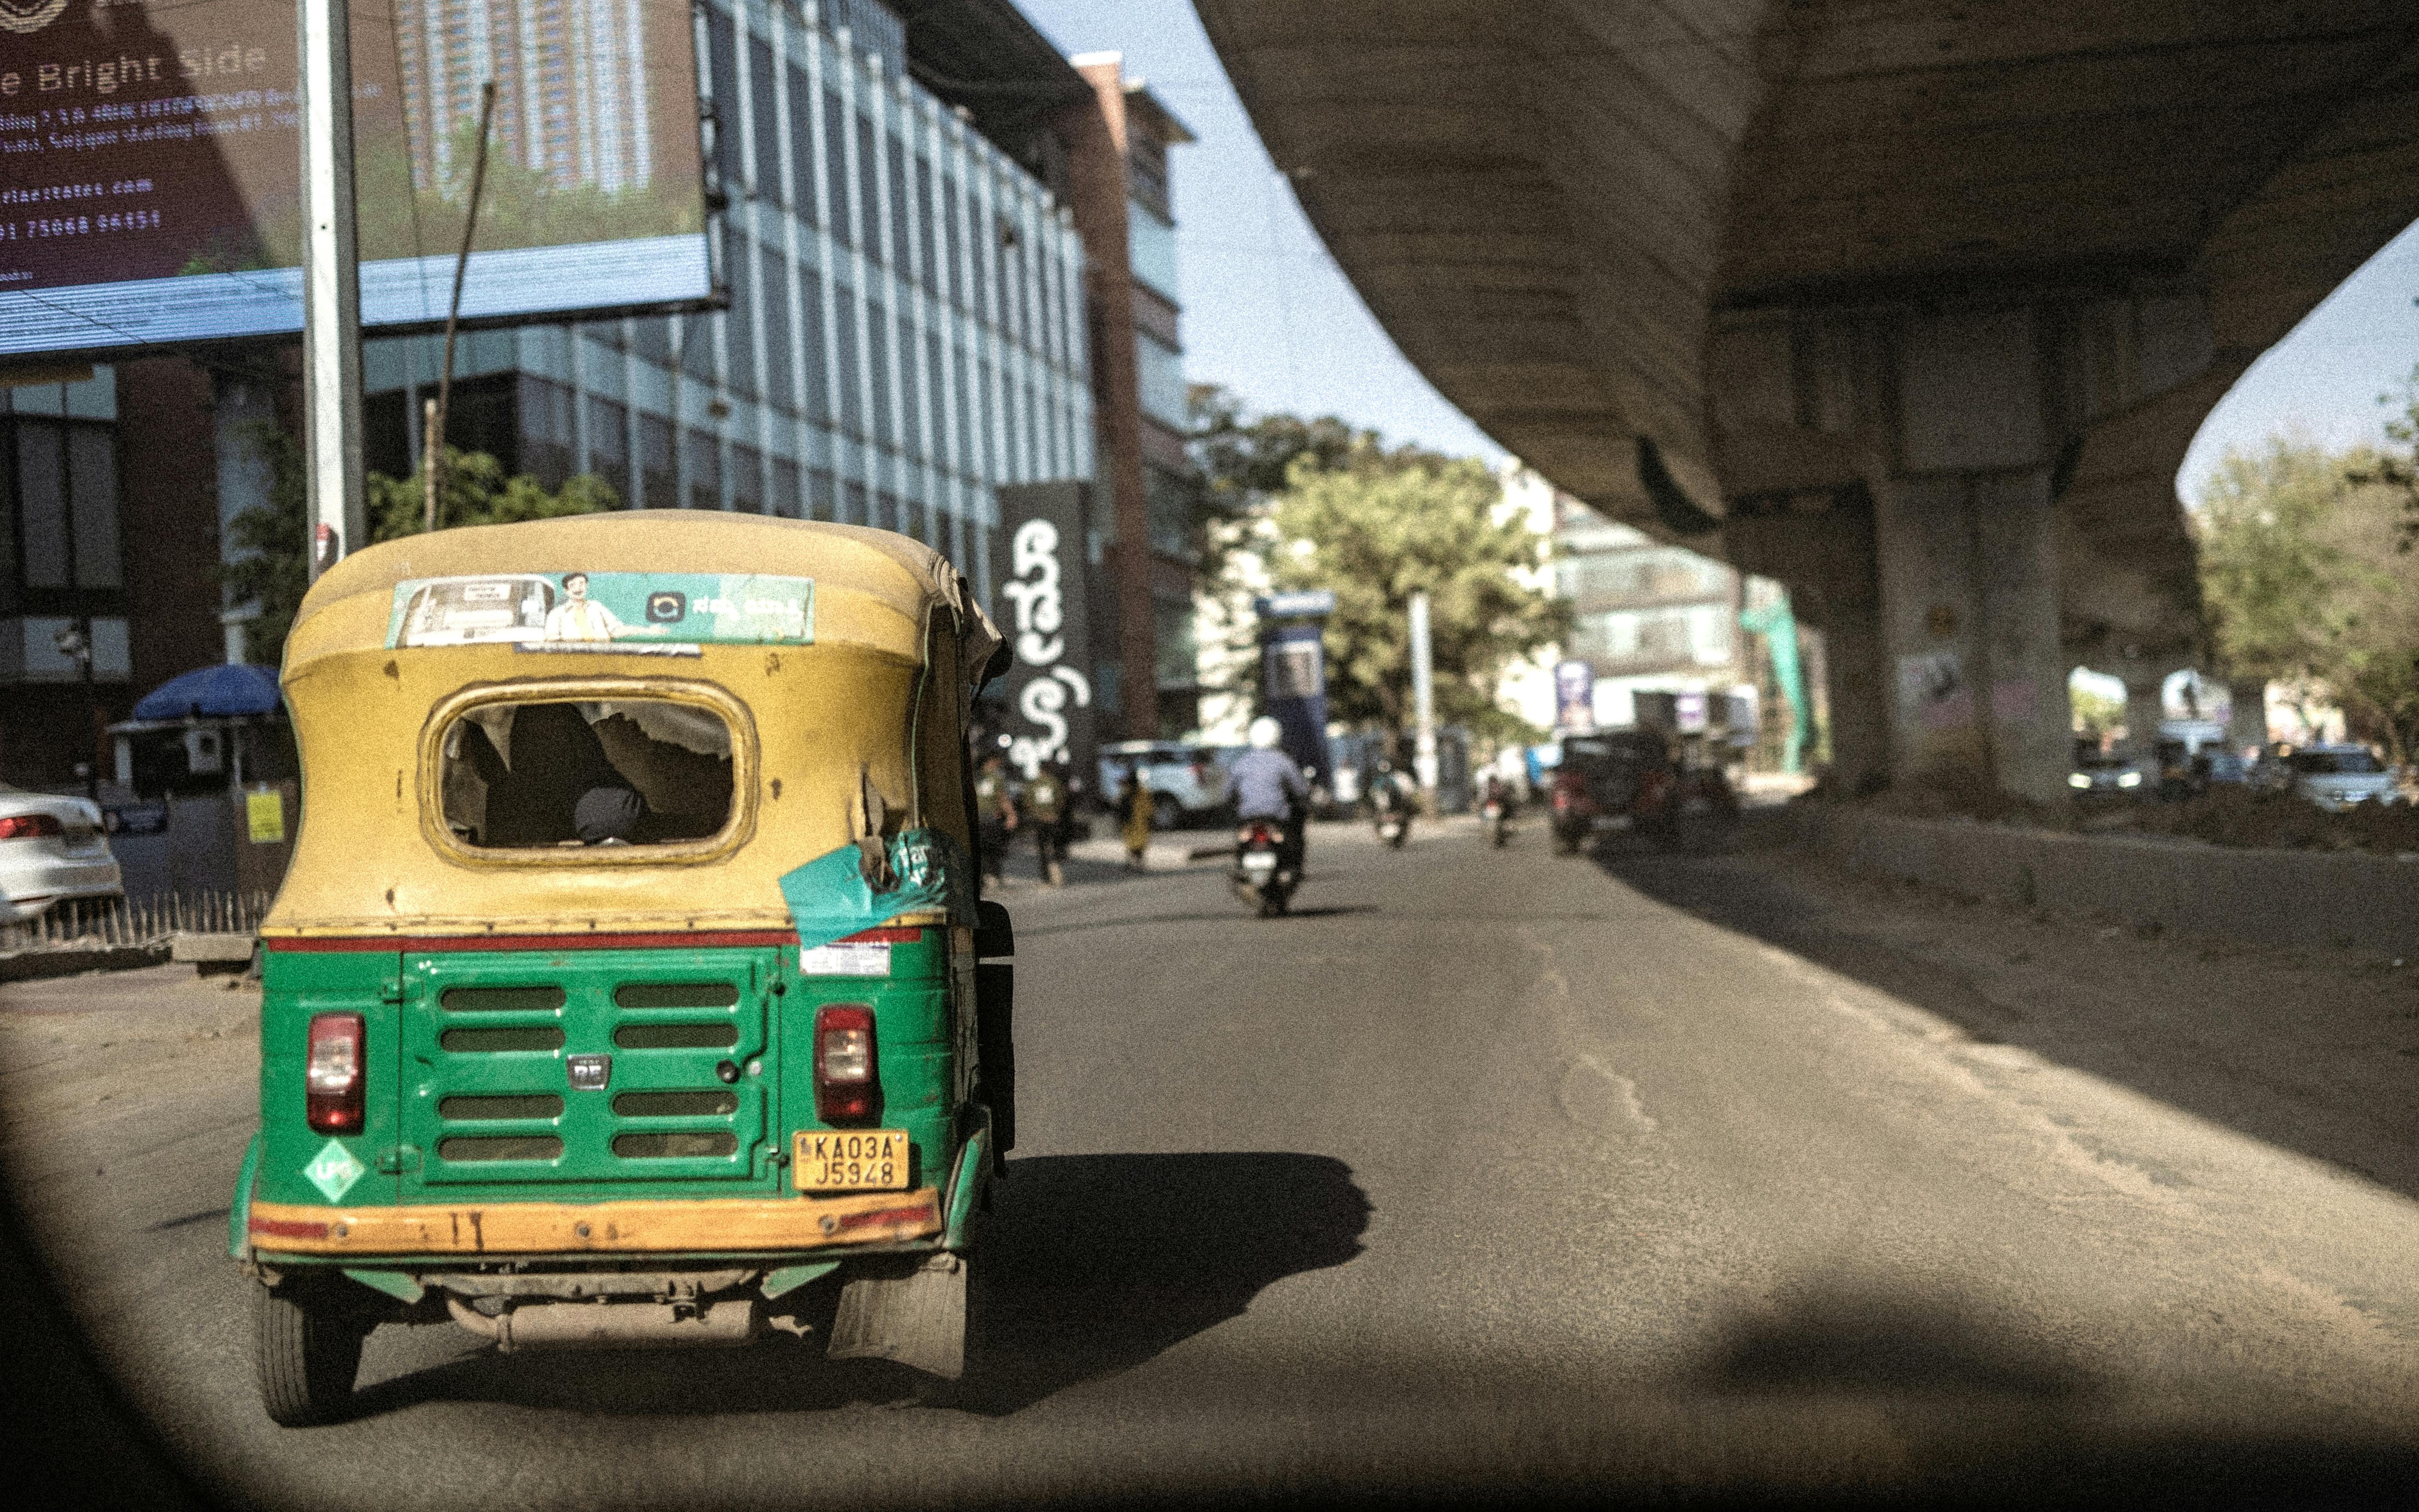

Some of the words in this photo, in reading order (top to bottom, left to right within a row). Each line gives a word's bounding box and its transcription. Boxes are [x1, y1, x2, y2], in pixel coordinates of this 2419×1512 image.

[38, 55, 162, 95] Bright
[179, 44, 267, 79] Side
[815, 1136, 893, 1160] KA03A
[816, 1161, 894, 1185] J5948
